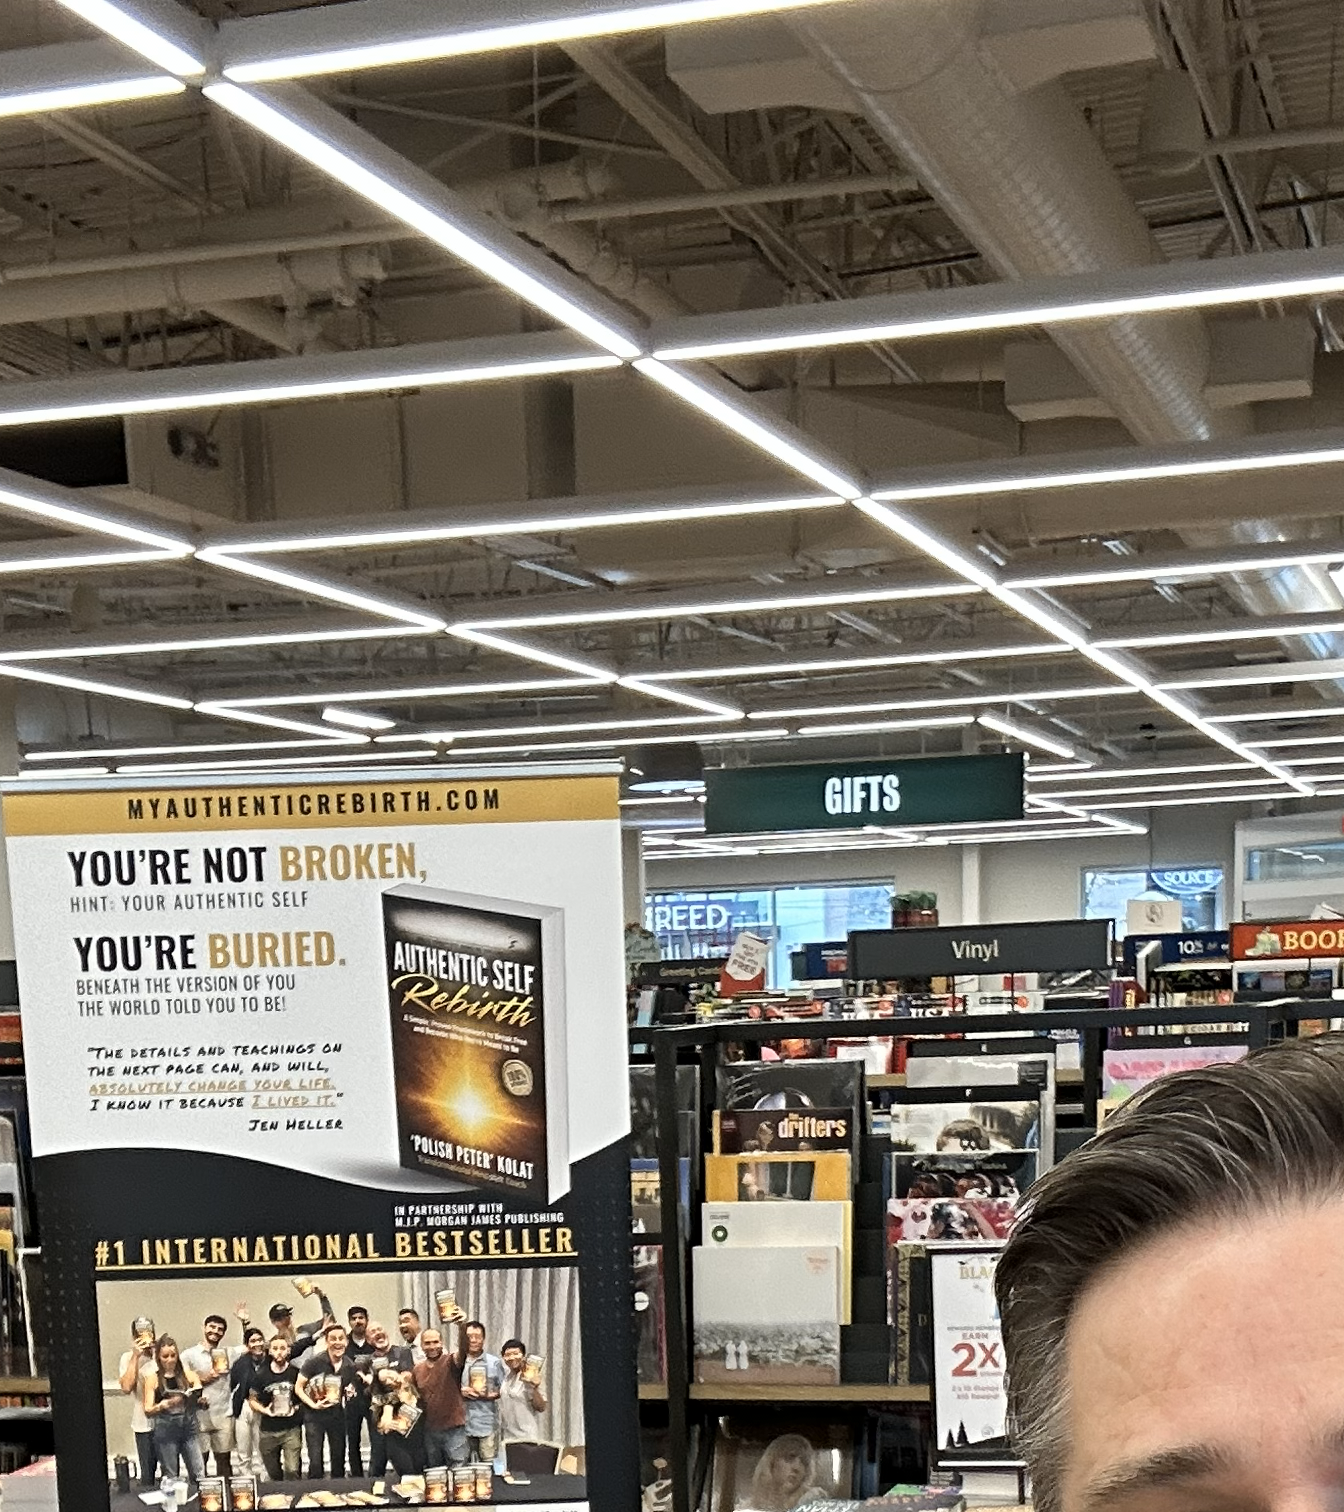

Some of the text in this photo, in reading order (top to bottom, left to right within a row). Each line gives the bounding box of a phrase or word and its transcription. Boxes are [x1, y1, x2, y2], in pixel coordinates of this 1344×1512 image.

[128, 789, 501, 820] MYAUTHENTICREBIRTH.COM
[825, 774, 901, 815] GIFTS
[67, 842, 428, 887] YOU'RE NOT BROKEN,
[70, 891, 308, 912] HINT: YOUR AUTHENTIC SELF
[74, 931, 345, 972] YOU'RE BURIED.
[952, 940, 999, 962] Vinyl
[394, 941, 535, 995] AUTHENTIC SELF
[77, 974, 295, 995] BENEATH THE VERSION OF YOU
[78, 996, 287, 1017] THE WORLD TOLD YOU TO BE!
[391, 973, 537, 1028] Rebirth
[130, 1047, 190, 1058] DETAILS
[197, 1046, 226, 1056] AND
[233, 1044, 315, 1056] TEACHINGS
[322, 1044, 342, 1053] ON
[88, 1061, 329, 1077] THE NEXT PAGE CAN, AND WILL,
[89, 1078, 335, 1094] ABSOLUTELY CHANGE YOUR LIFE.
[248, 1118, 343, 1132] JEN HELLER
[778, 1115, 847, 1139] drifters
[95, 1228, 574, 1266] #1 INTERNATIONAL BESTSELLER
[951, 1342, 1001, 1378] 2X
